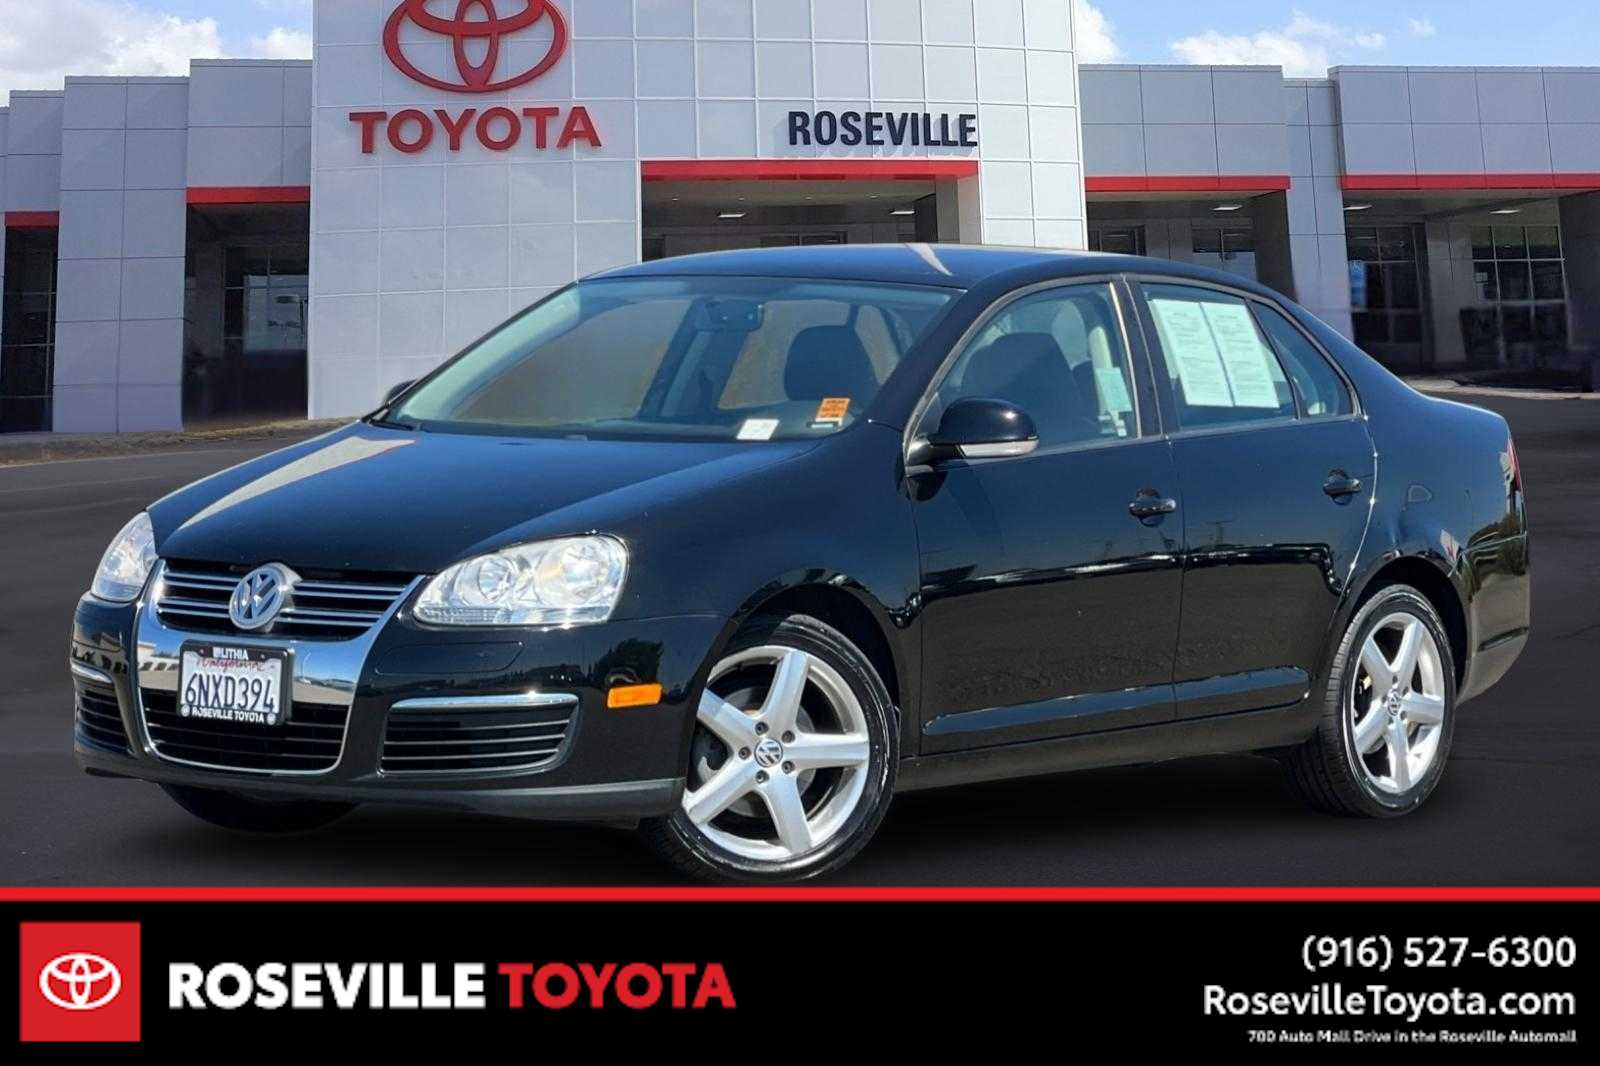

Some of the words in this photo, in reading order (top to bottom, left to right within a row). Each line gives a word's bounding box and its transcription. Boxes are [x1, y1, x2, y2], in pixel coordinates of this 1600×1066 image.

[349, 106, 602, 154] TOYOTA
[788, 111, 978, 147] ROSEVILLE
[185, 672, 275, 714] 6NXD394
[191, 707, 233, 720] ROSEVILLE
[234, 710, 265, 723] TOYOTA
